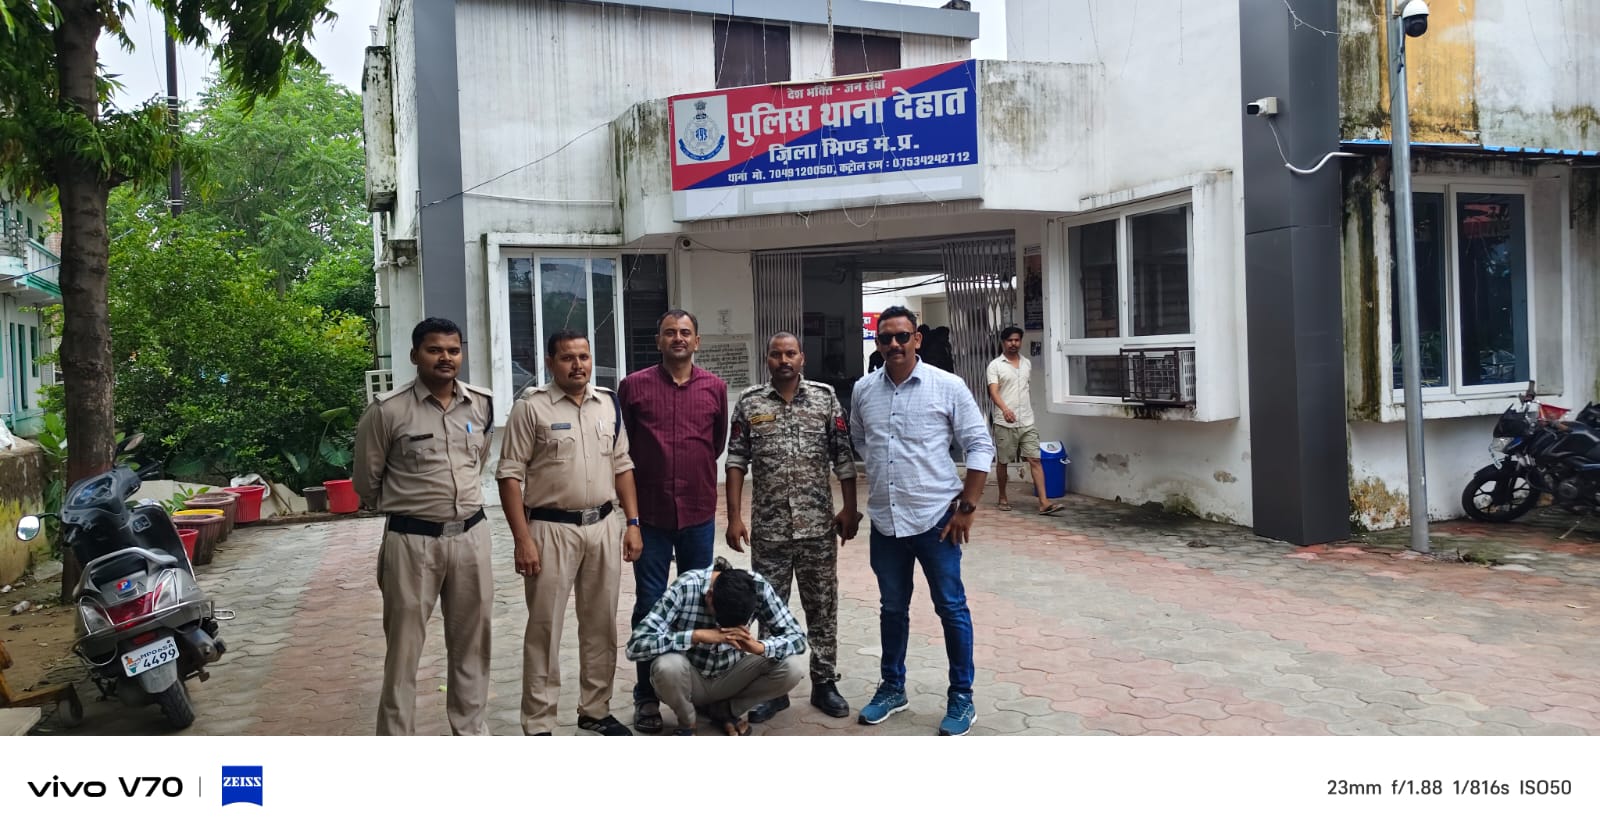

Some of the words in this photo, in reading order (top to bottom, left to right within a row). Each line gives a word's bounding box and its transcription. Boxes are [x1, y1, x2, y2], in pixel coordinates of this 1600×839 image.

[787, 88, 803, 100] देश
[806, 85, 833, 98] भक्ति
[844, 82, 862, 93] जन
[732, 103, 812, 147] पुलिस
[820, 97, 886, 128] थाना
[892, 87, 968, 120] देहात
[821, 138, 869, 158] भिण्ड
[728, 172, 747, 182] थाना
[752, 170, 766, 181] मो.
[893, 152, 970, 168] 07534242712
[143, 648, 176, 668] 4499
